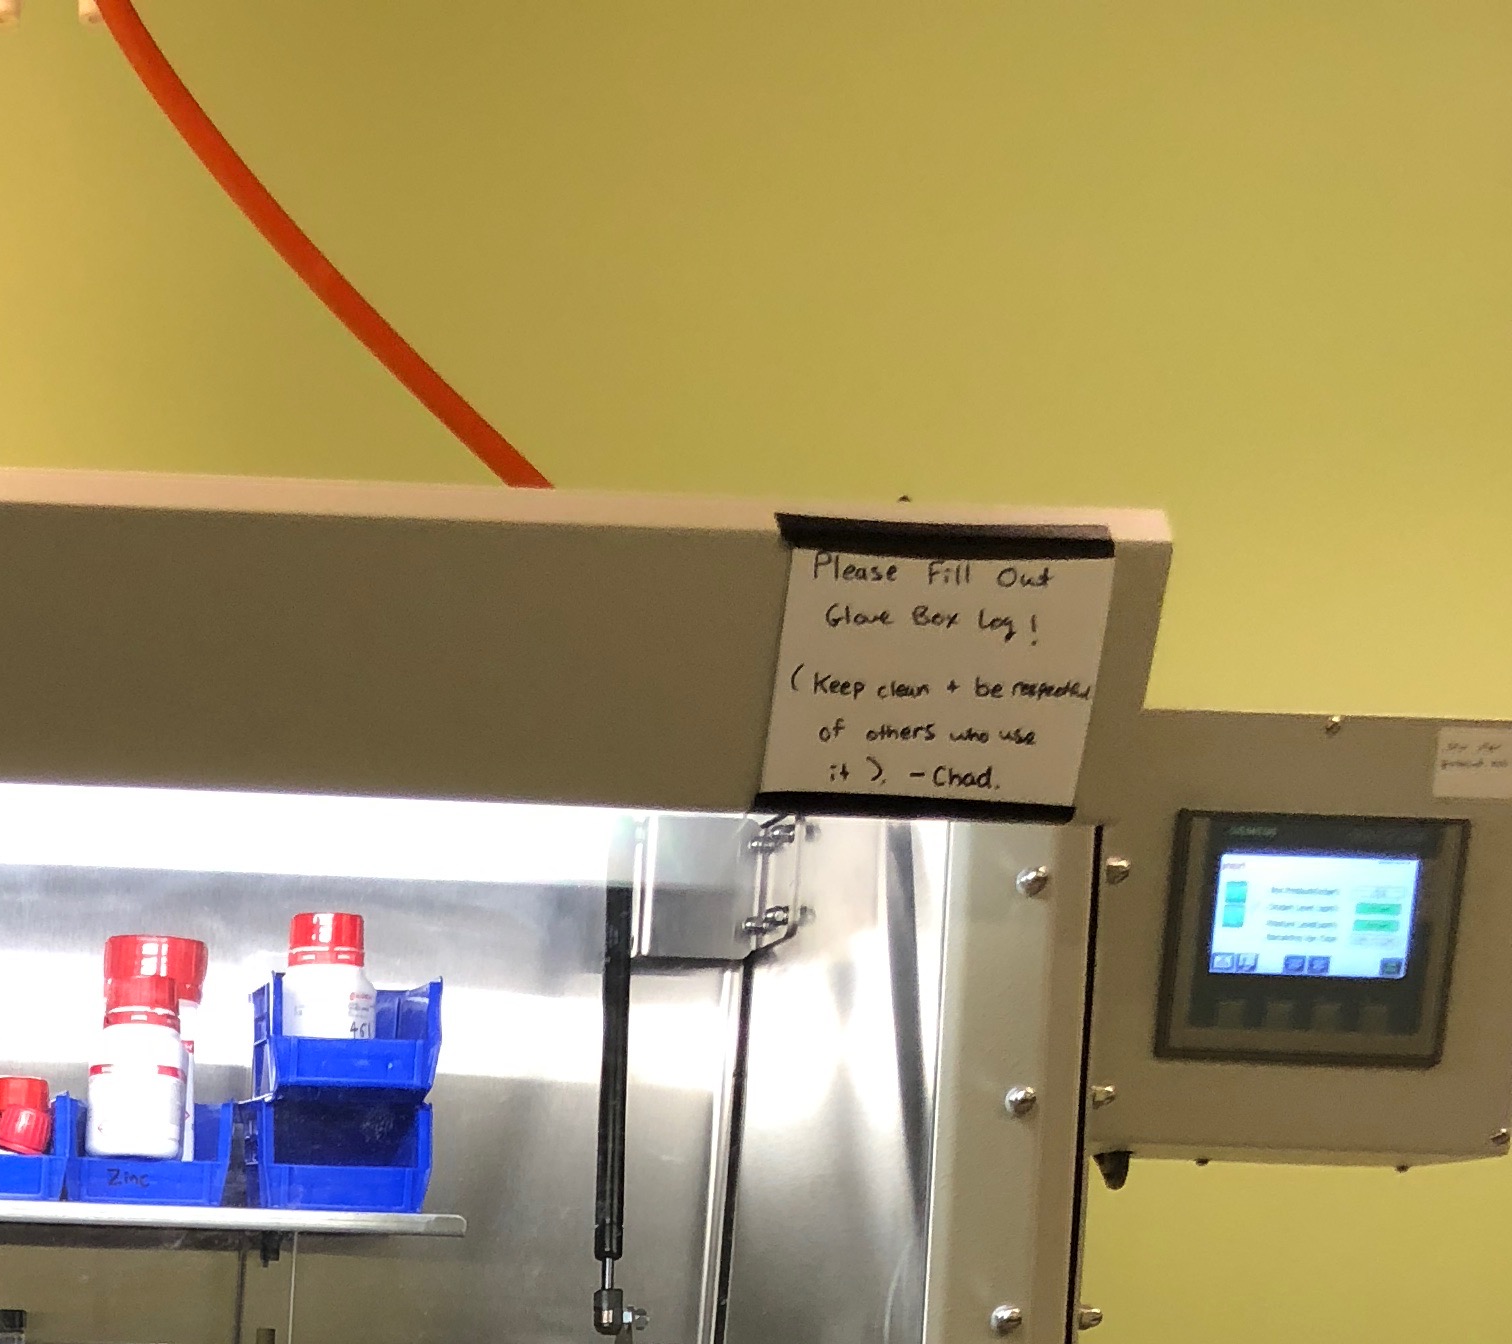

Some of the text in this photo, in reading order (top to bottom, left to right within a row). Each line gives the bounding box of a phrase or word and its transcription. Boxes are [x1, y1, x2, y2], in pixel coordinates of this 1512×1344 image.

[813, 552, 1055, 589] Please Fill Out
[825, 604, 894, 628] Glove
[912, 606, 960, 628] Box
[877, 678, 930, 699] clean
[975, 676, 1003, 698] be
[818, 720, 1037, 746] of others who use
[106, 1168, 151, 1188] Zinc
